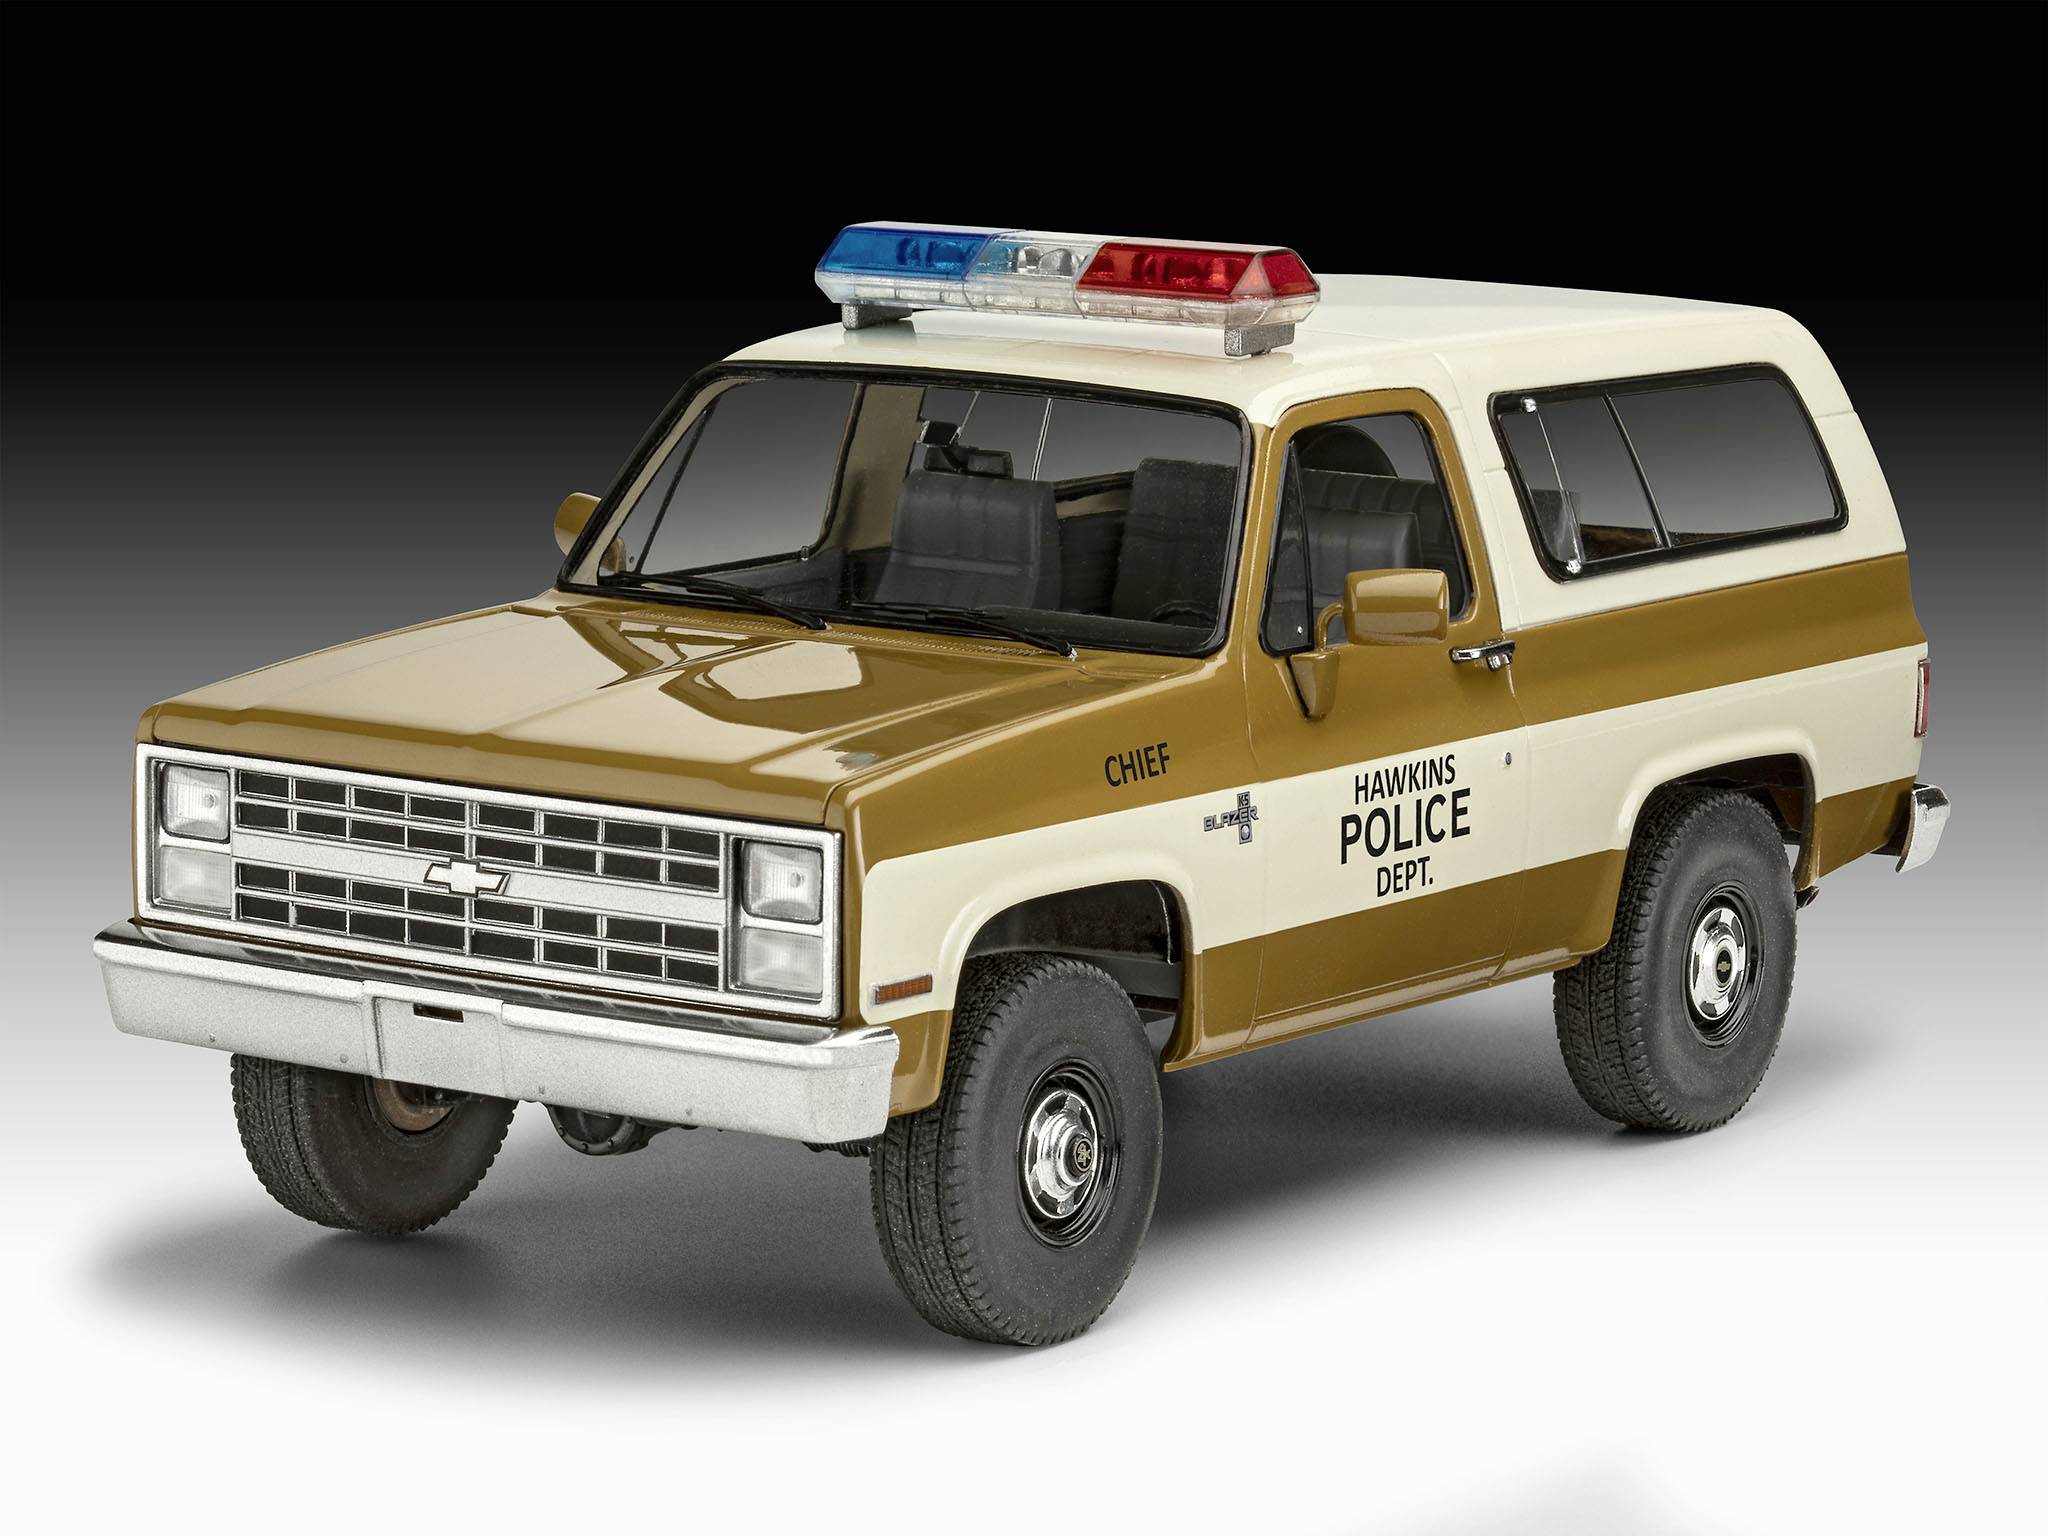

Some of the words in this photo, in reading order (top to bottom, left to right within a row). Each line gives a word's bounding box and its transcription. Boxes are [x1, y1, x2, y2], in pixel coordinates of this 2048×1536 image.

[1104, 741, 1170, 788] CHIEF
[1354, 754, 1456, 805] HAWKINS
[1203, 805, 1259, 832] BLAZER
[1340, 787, 1471, 865] POLICE
[1376, 855, 1434, 898] DEPT.
